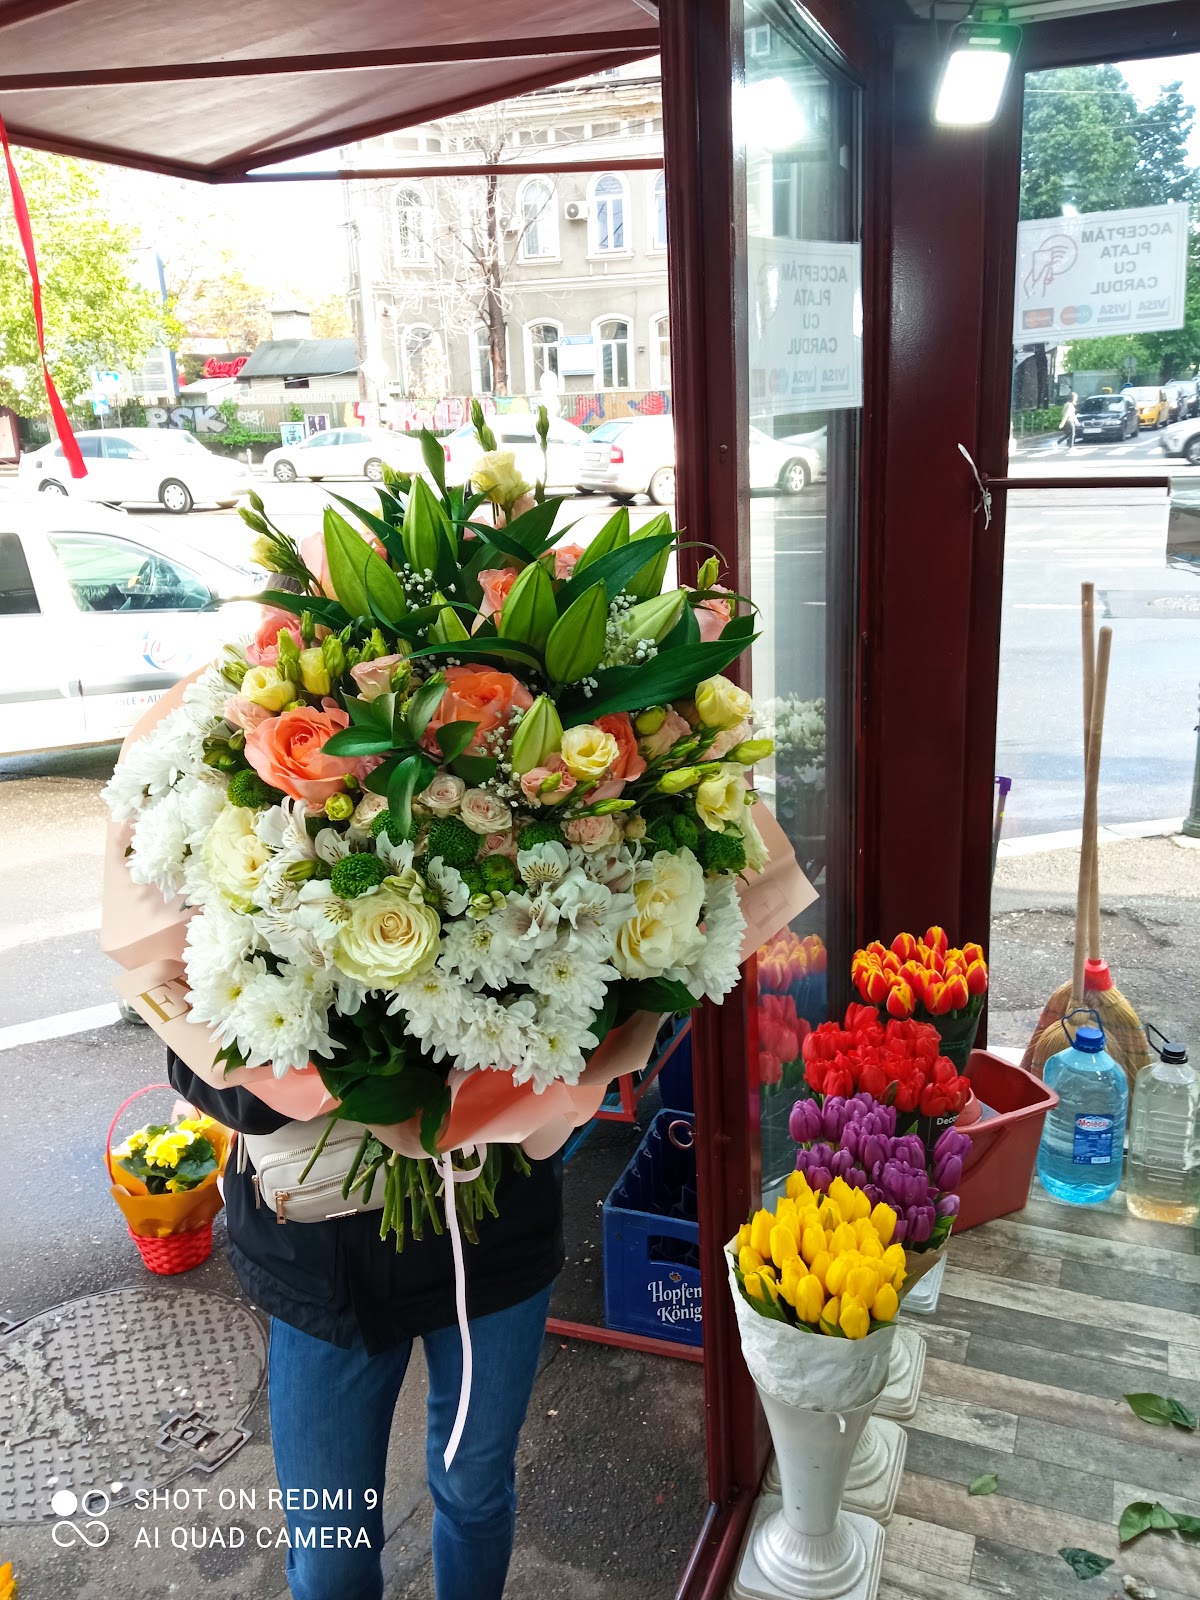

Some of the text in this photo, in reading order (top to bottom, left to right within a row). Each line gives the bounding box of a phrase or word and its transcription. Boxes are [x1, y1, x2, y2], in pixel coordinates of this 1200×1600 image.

[936, 1114, 959, 1126] Deco
[647, 1280, 702, 1306] Hopfen
[657, 1302, 702, 1323] König
